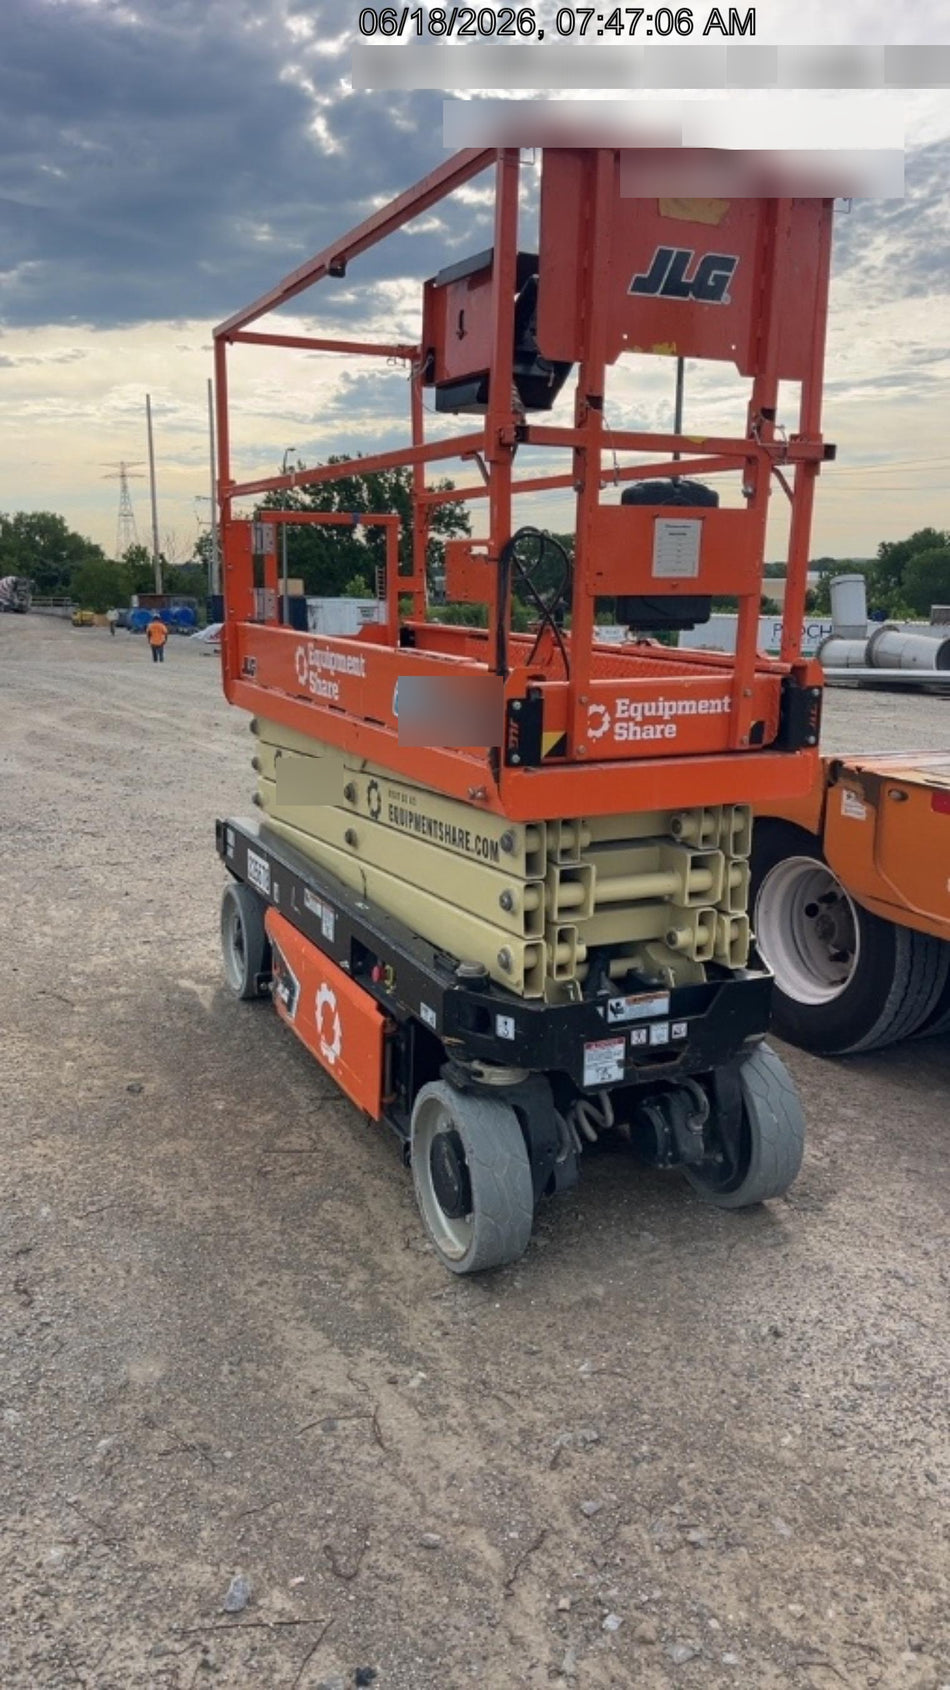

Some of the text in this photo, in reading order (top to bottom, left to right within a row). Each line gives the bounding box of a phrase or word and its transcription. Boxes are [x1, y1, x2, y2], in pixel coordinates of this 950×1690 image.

[627, 246, 739, 304] JLG
[307, 642, 366, 678] Equipment
[309, 670, 339, 700] Share
[615, 696, 731, 721] Equipment
[613, 722, 677, 741] Share
[388, 803, 500, 861] EQUIPMENTSHARE.COM
